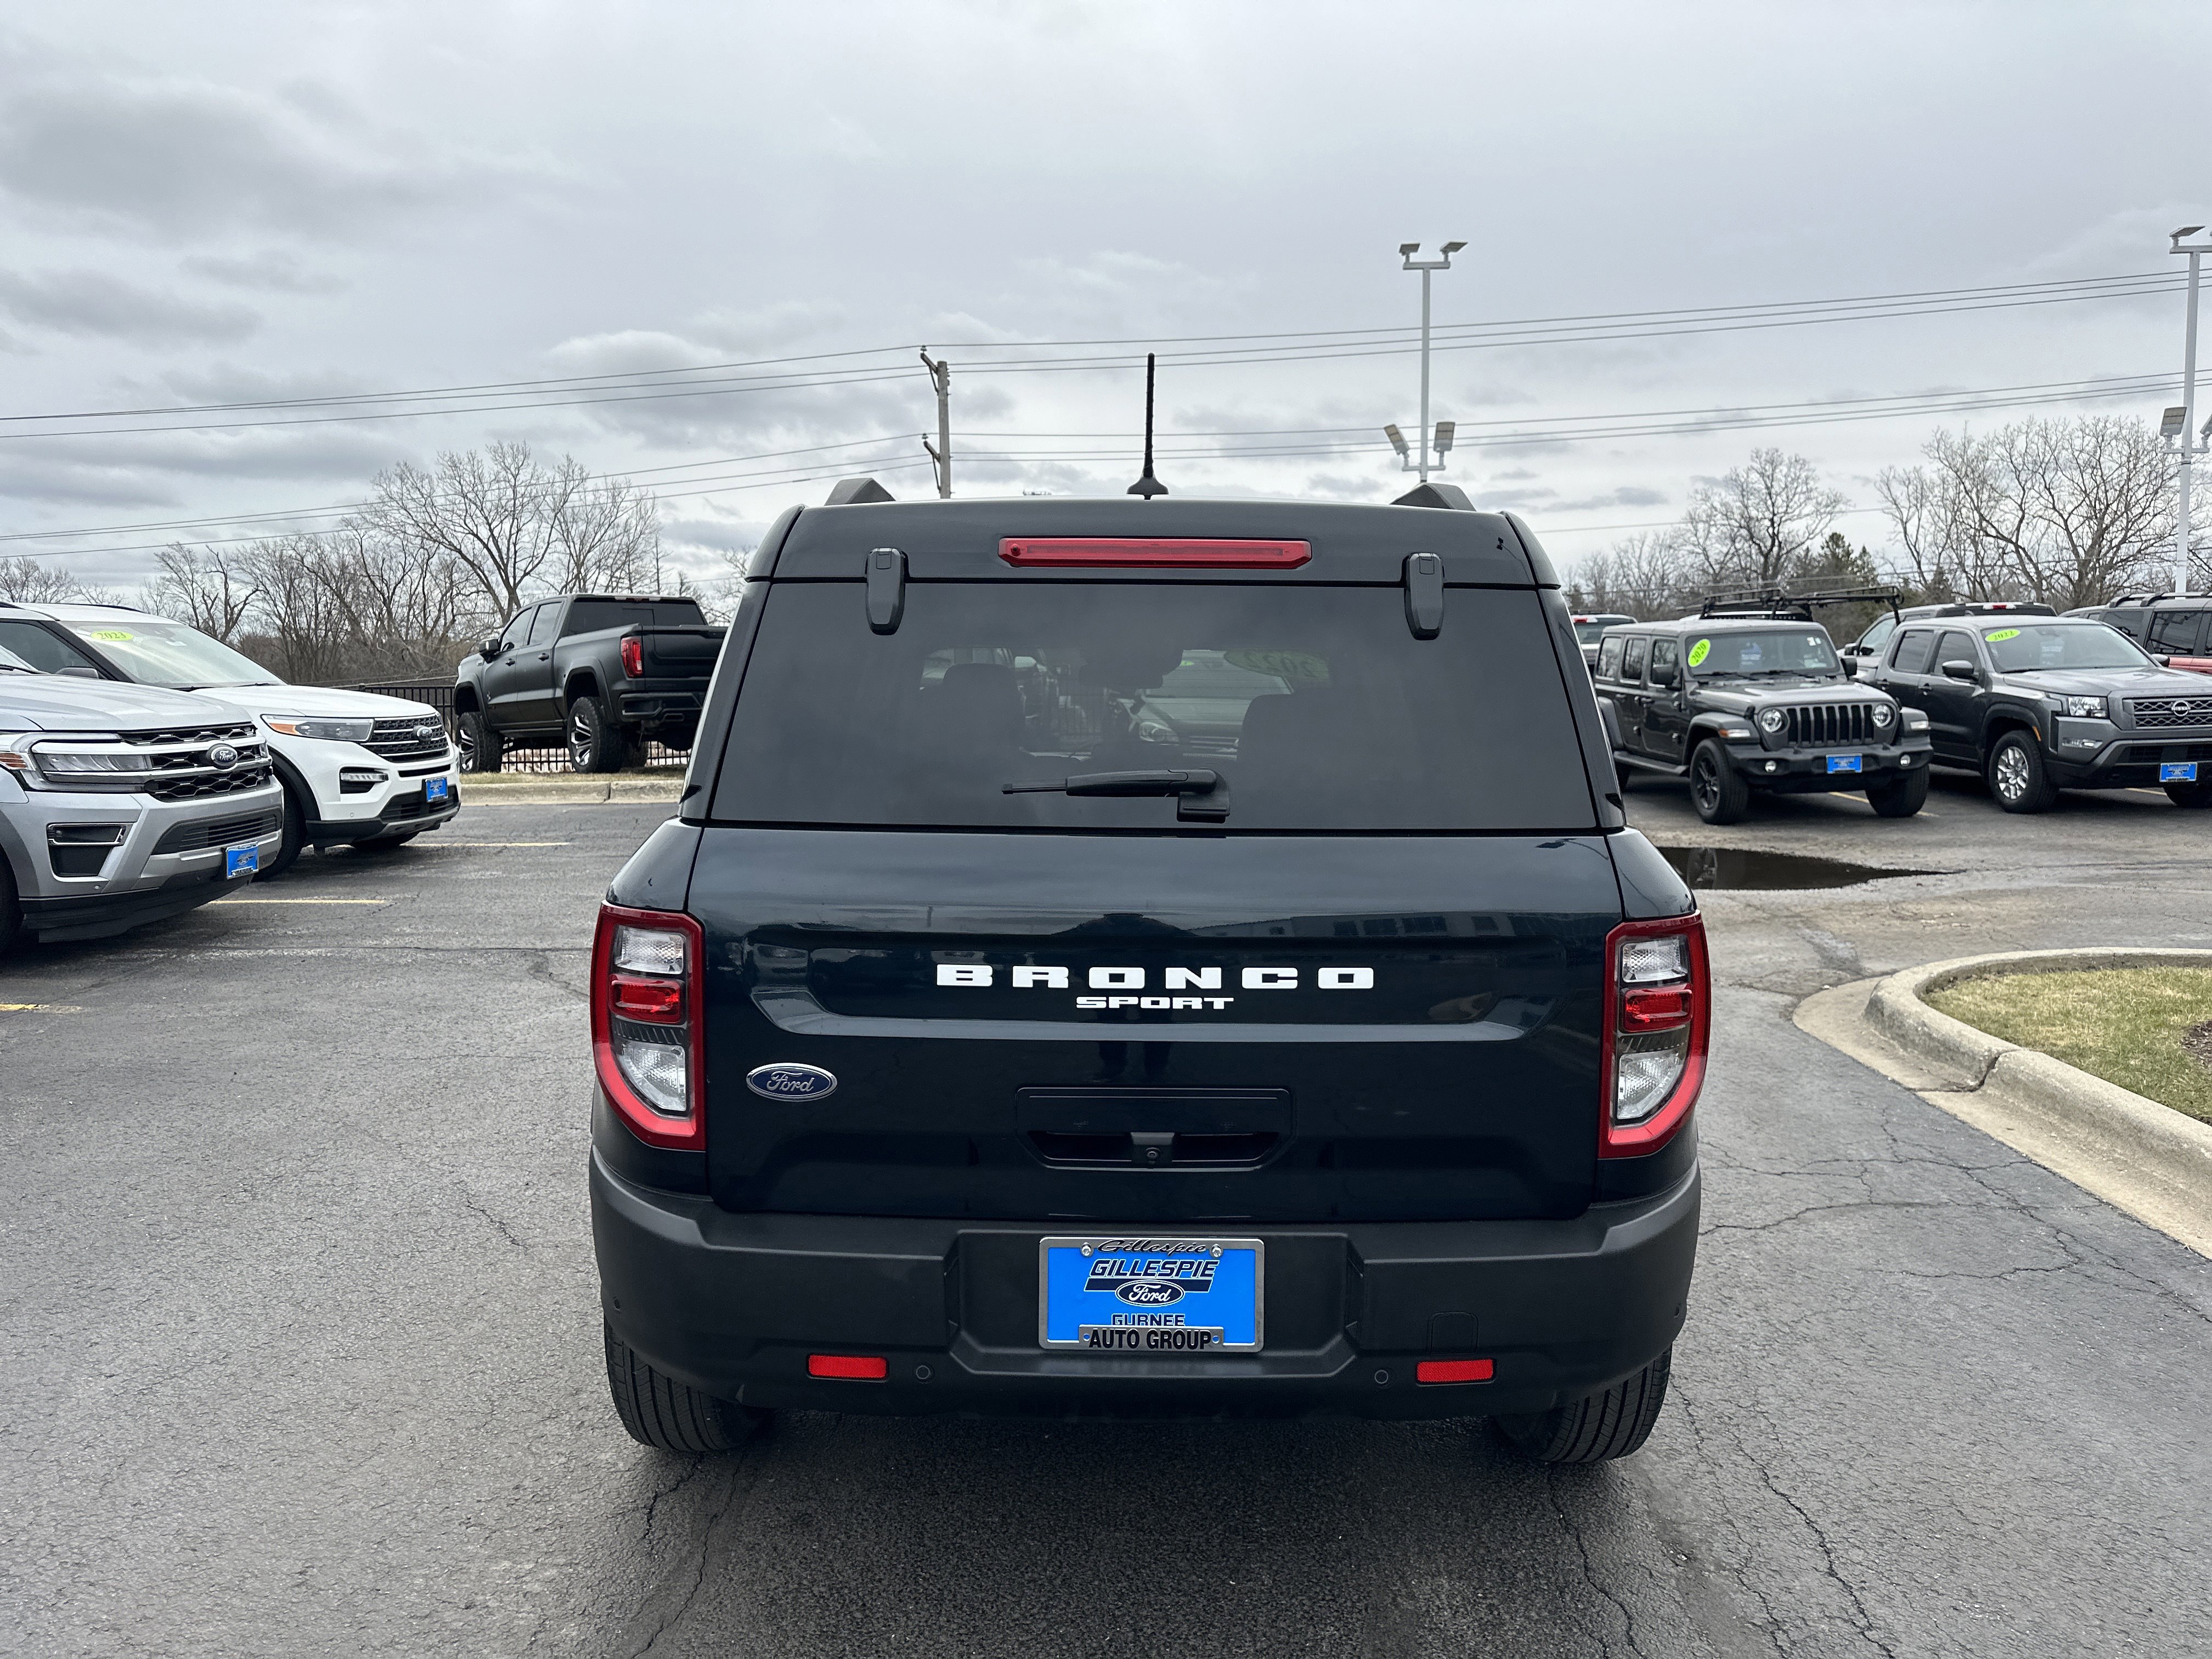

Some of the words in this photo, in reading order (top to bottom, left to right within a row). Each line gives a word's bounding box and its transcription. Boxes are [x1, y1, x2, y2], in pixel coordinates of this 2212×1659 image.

[97, 631, 126, 640] 2023
[1691, 643, 1706, 663] 2020
[936, 964, 1374, 989] BRONCO
[1076, 996, 1234, 1010] SPORT
[766, 1070, 815, 1092] Ford
[1098, 1239, 1206, 1256] Gillespie
[1089, 1259, 1220, 1278] GILLESPIE
[1128, 1284, 1172, 1302] Ford
[1111, 1313, 1186, 1327] GURNEE
[1088, 1328, 1141, 1349] AUTO
[1146, 1329, 1212, 1350] GROUP
